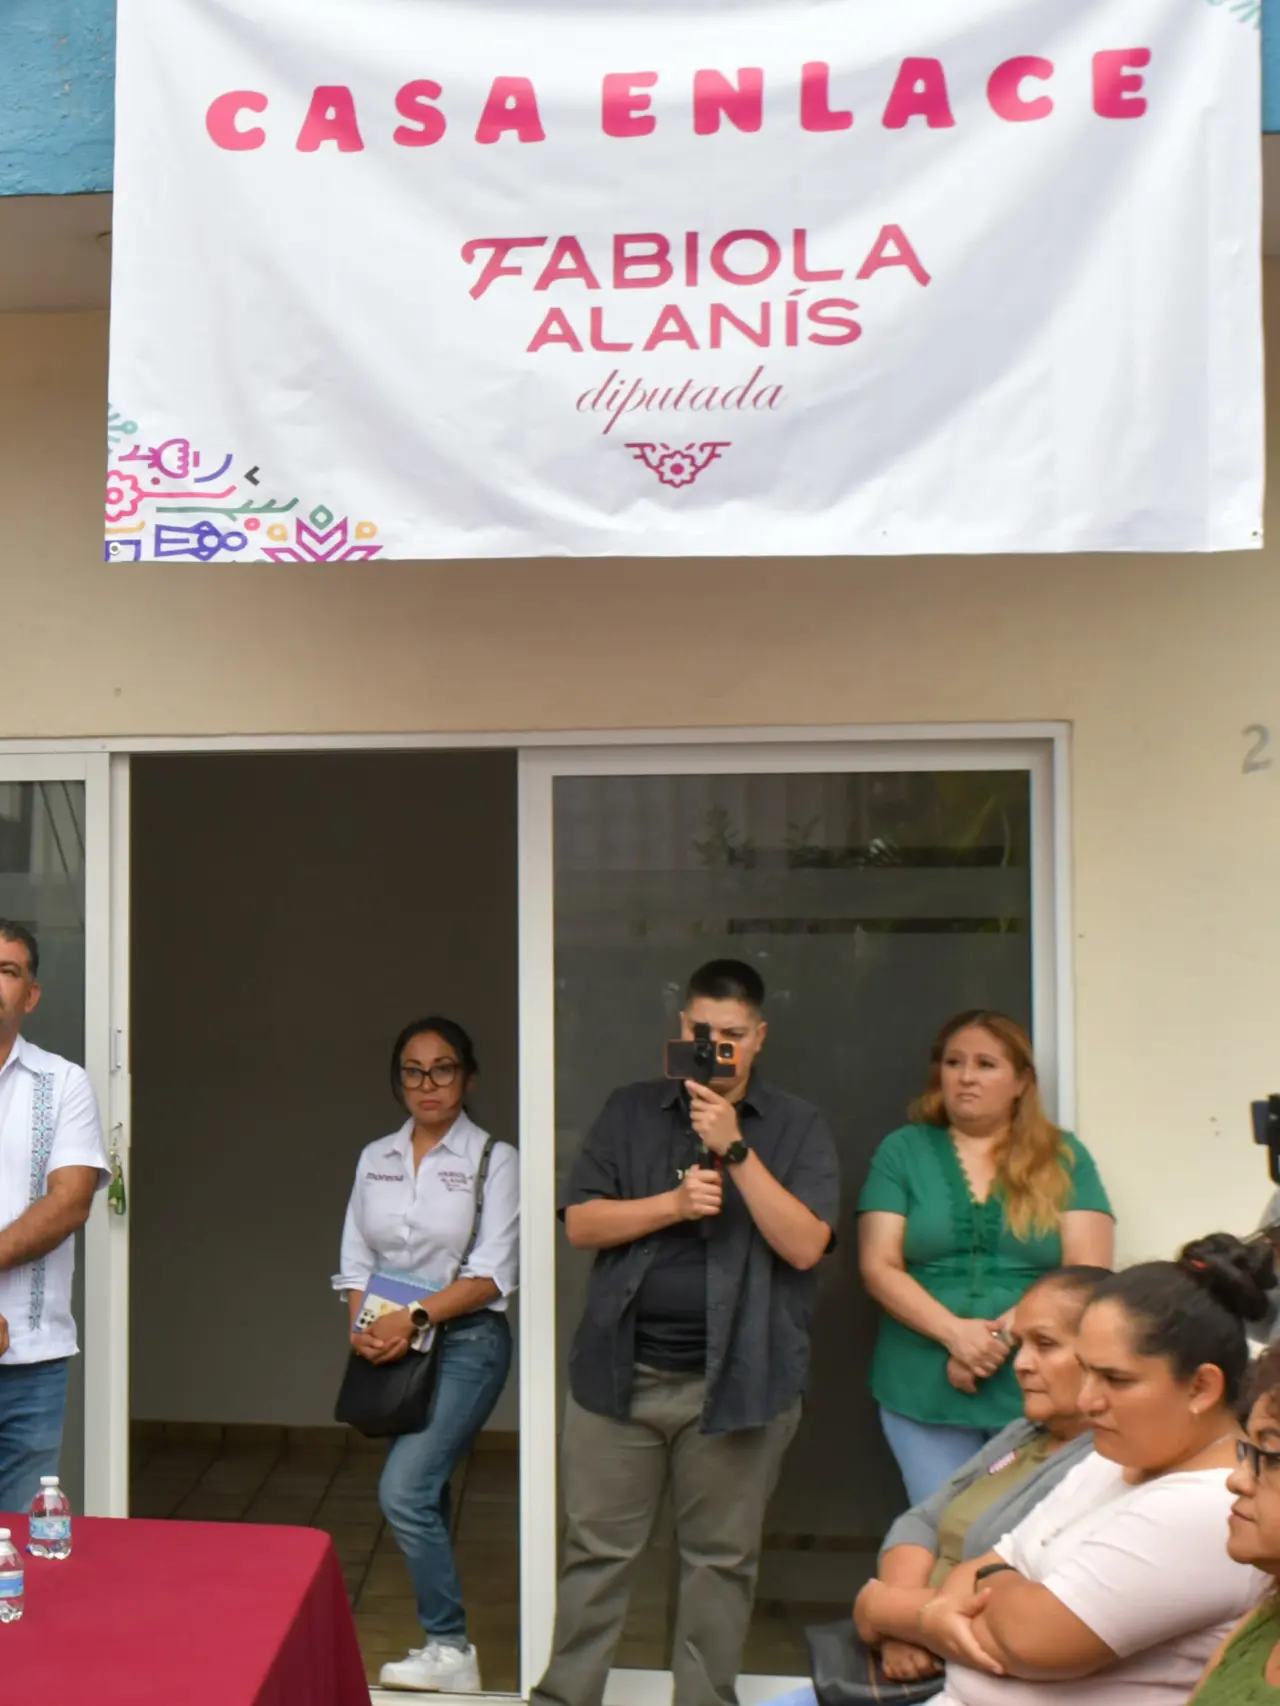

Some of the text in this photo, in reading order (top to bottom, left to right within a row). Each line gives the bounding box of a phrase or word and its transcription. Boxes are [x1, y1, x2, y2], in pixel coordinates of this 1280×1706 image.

[205, 47, 1152, 153] CASA ENLACE
[460, 224, 932, 300] FABIOLA
[526, 288, 862, 353] ALANÍS
[576, 365, 787, 434] diputada
[1240, 723, 1273, 775] 2
